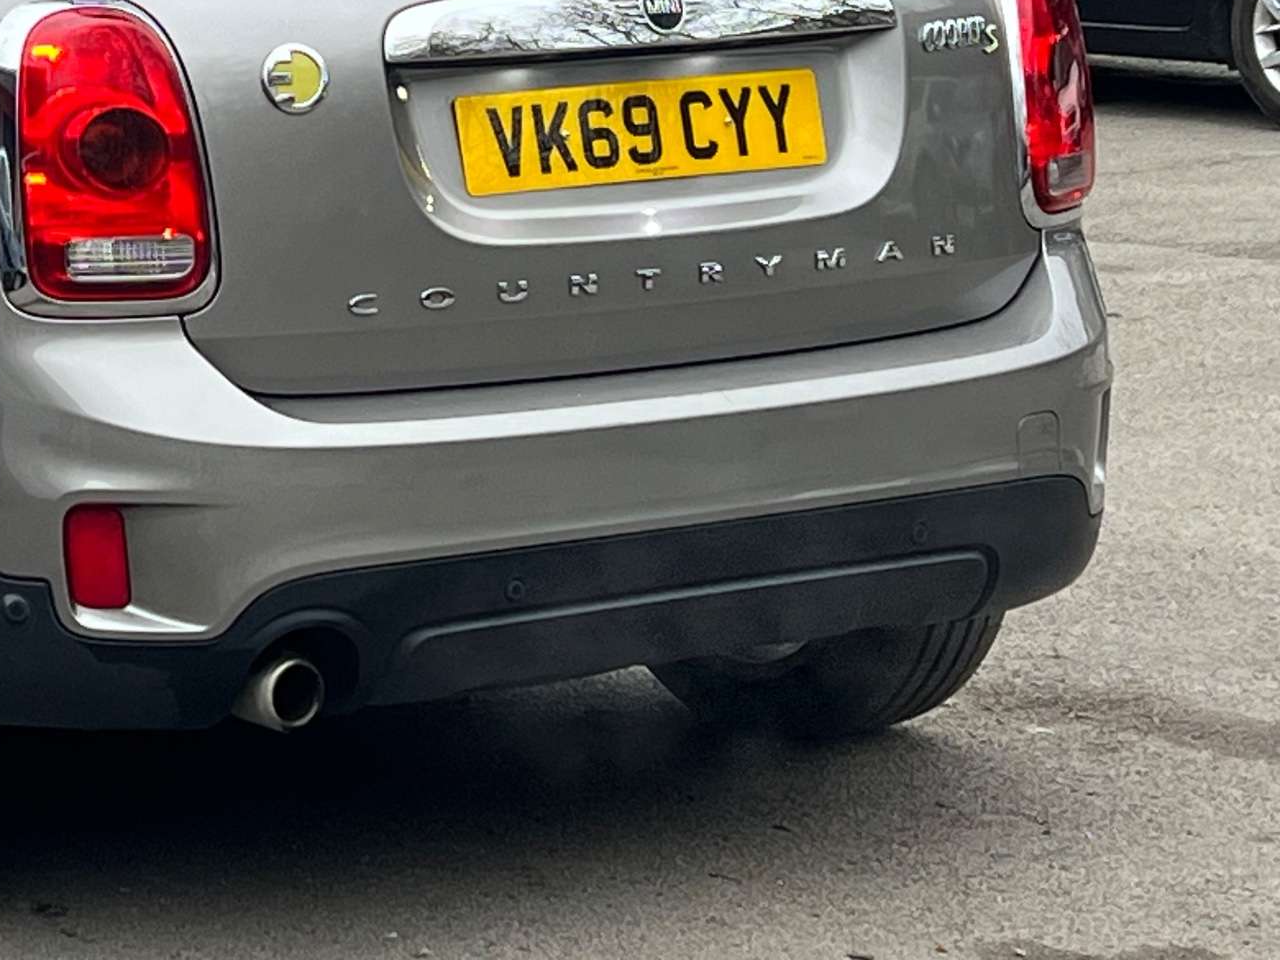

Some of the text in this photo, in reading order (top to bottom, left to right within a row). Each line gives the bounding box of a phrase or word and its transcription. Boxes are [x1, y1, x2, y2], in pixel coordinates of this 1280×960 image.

[486, 84, 790, 178] VK69 CYY
[348, 234, 955, 315] COUNTRYMAN
